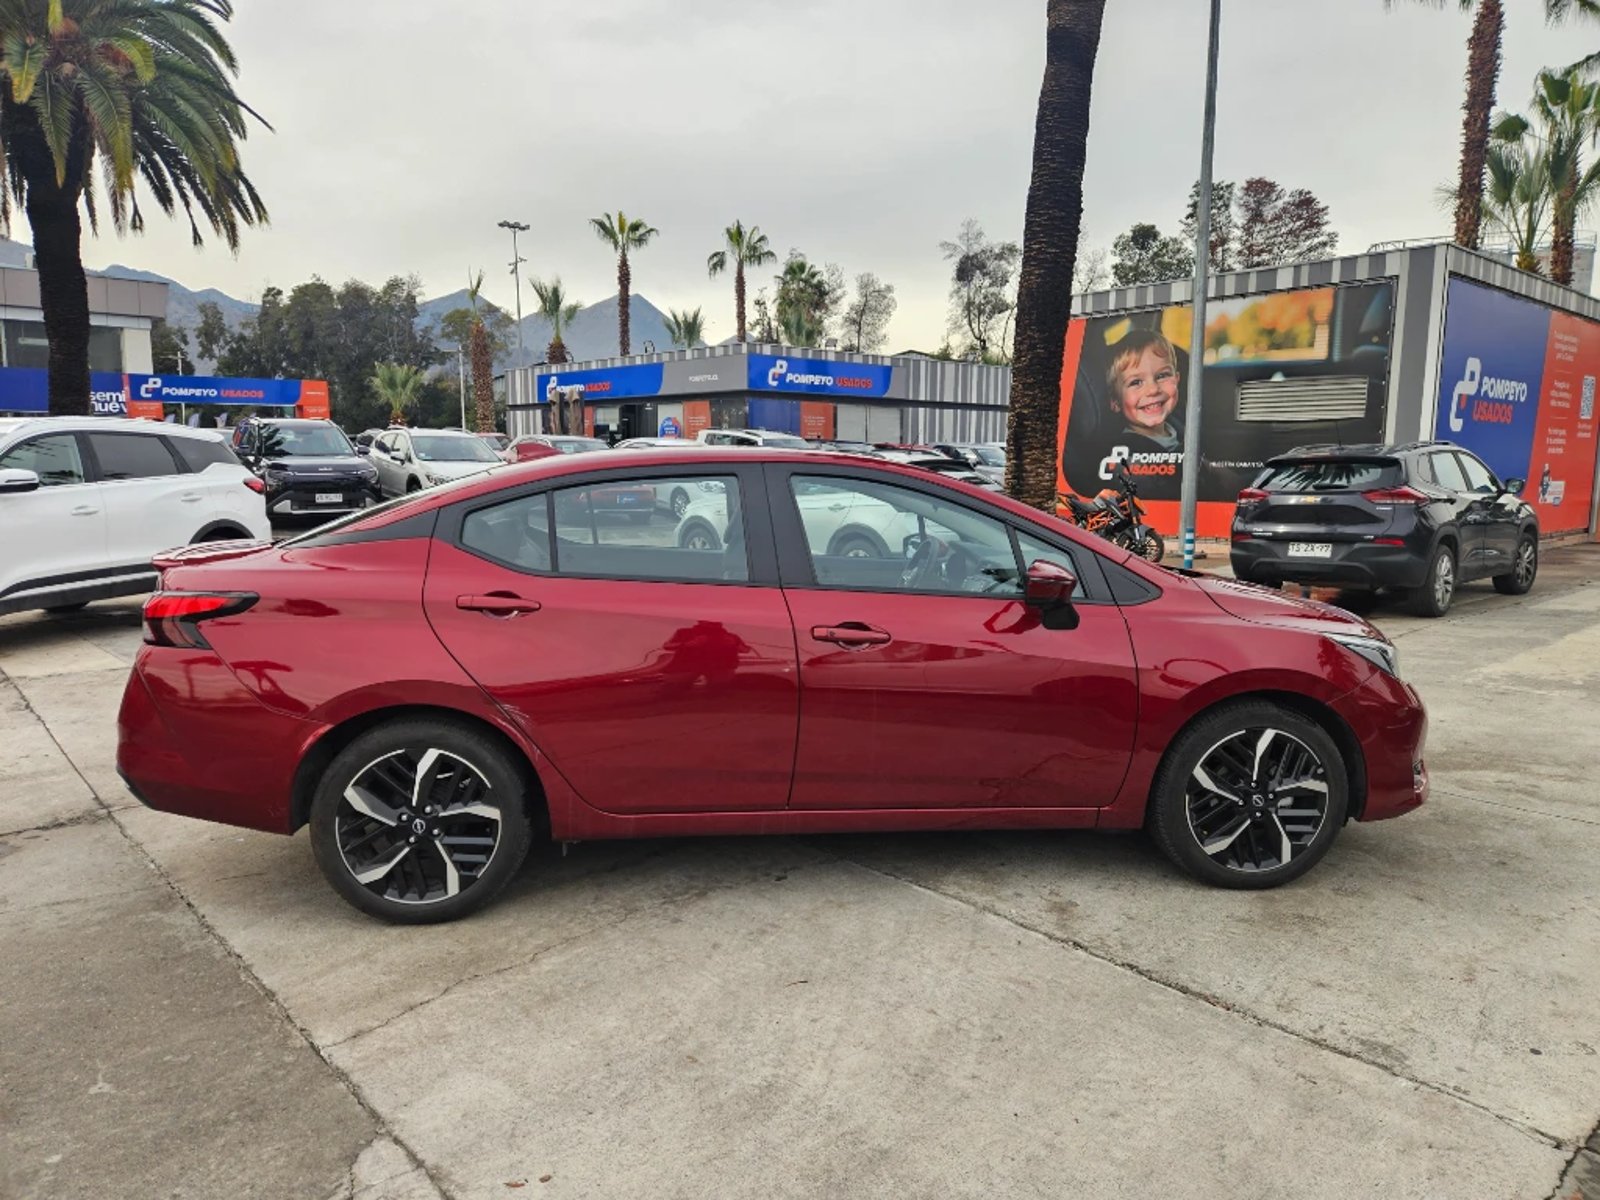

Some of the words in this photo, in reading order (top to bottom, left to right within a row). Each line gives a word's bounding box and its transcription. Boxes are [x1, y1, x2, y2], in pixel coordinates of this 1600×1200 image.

[786, 373, 834, 386] POMPEYO
[836, 377, 873, 389] USADOS
[90, 390, 126, 402] semi
[162, 387, 218, 397] POMPEYO
[220, 390, 264, 398] USADOS
[1481, 376, 1528, 402] POMPEYO
[1472, 400, 1514, 424] USADOS
[1131, 453, 1184, 463] POMPEY
